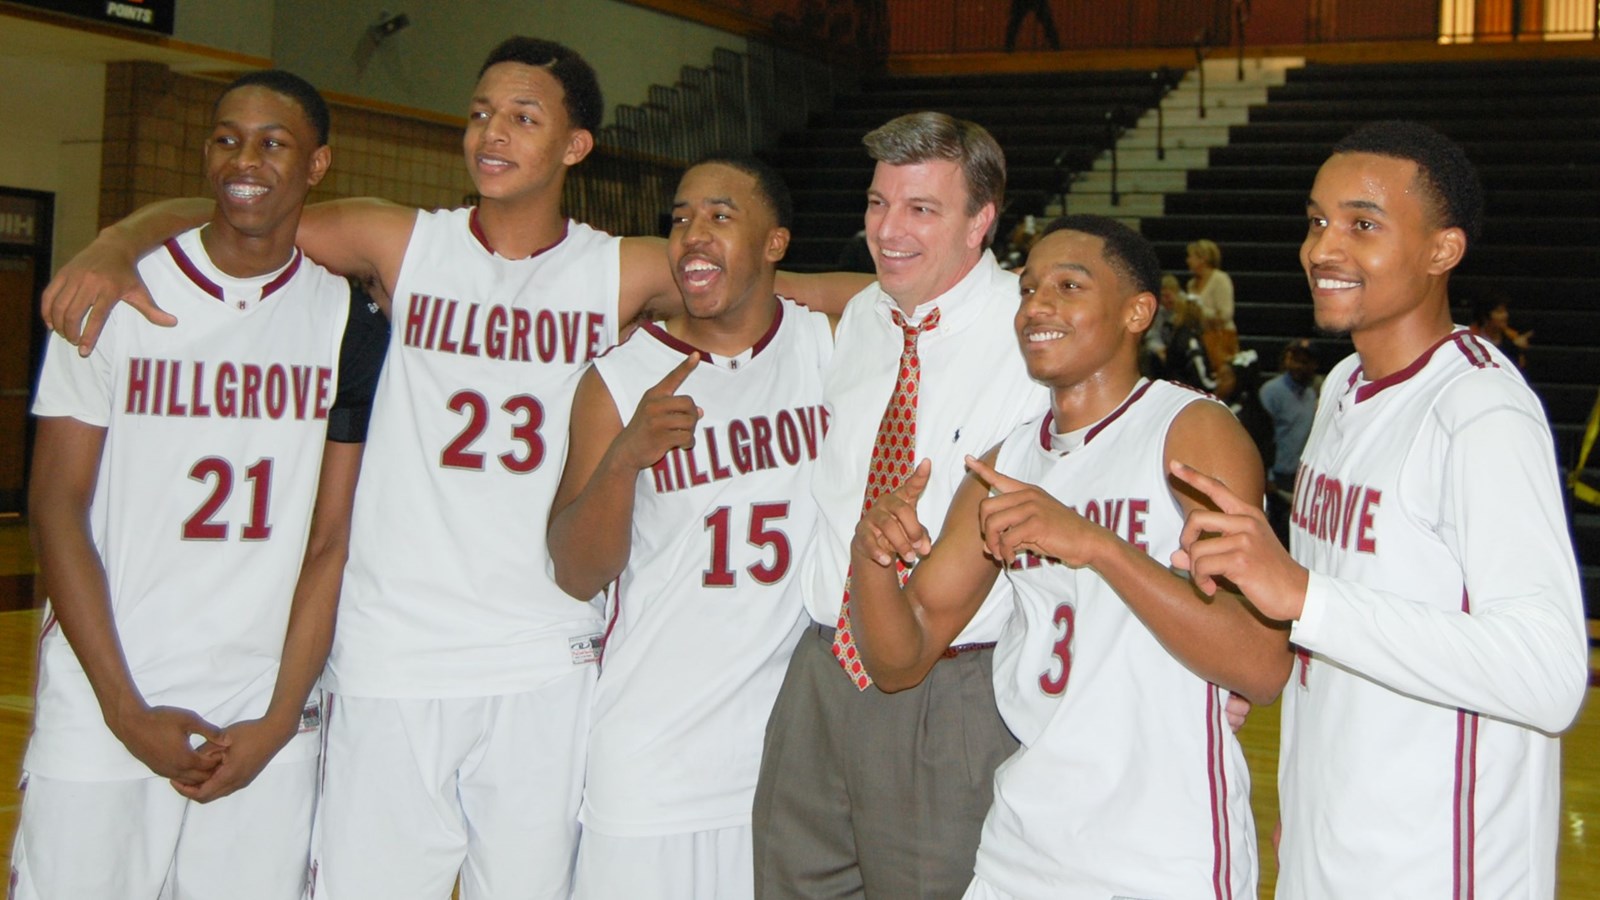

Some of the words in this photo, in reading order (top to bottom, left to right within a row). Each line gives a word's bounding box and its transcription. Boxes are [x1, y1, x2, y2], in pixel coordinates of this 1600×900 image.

[106, 1, 153, 24] POINTS
[404, 292, 605, 364] HILLGROVE
[125, 357, 332, 420] HILLGROVE
[440, 388, 547, 475] 23
[181, 454, 274, 542] 21
[702, 500, 793, 588] 15
[1038, 601, 1076, 698] 3
